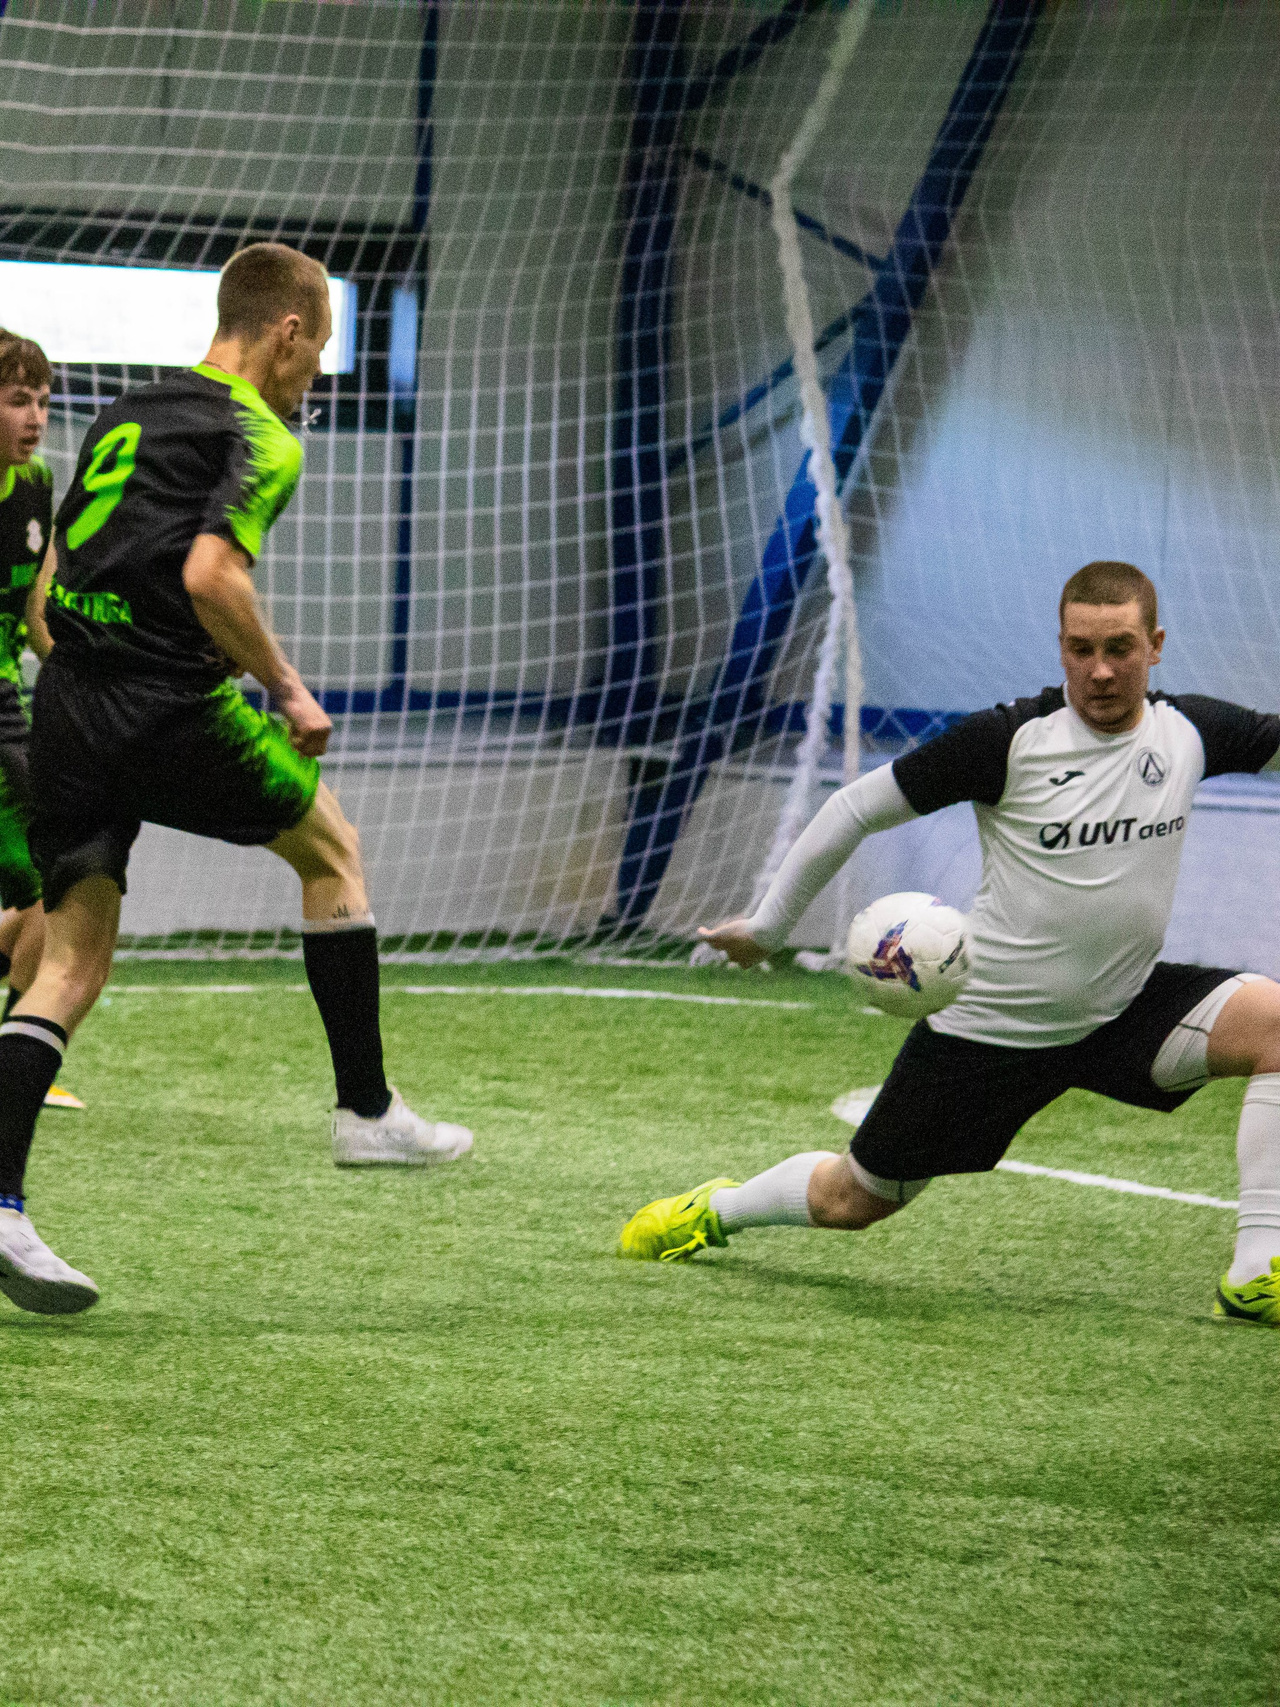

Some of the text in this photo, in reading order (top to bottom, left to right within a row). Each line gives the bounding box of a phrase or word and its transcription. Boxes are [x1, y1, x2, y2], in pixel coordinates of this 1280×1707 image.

[67, 422, 142, 550] 9
[1078, 815, 1185, 847] UVT aero
